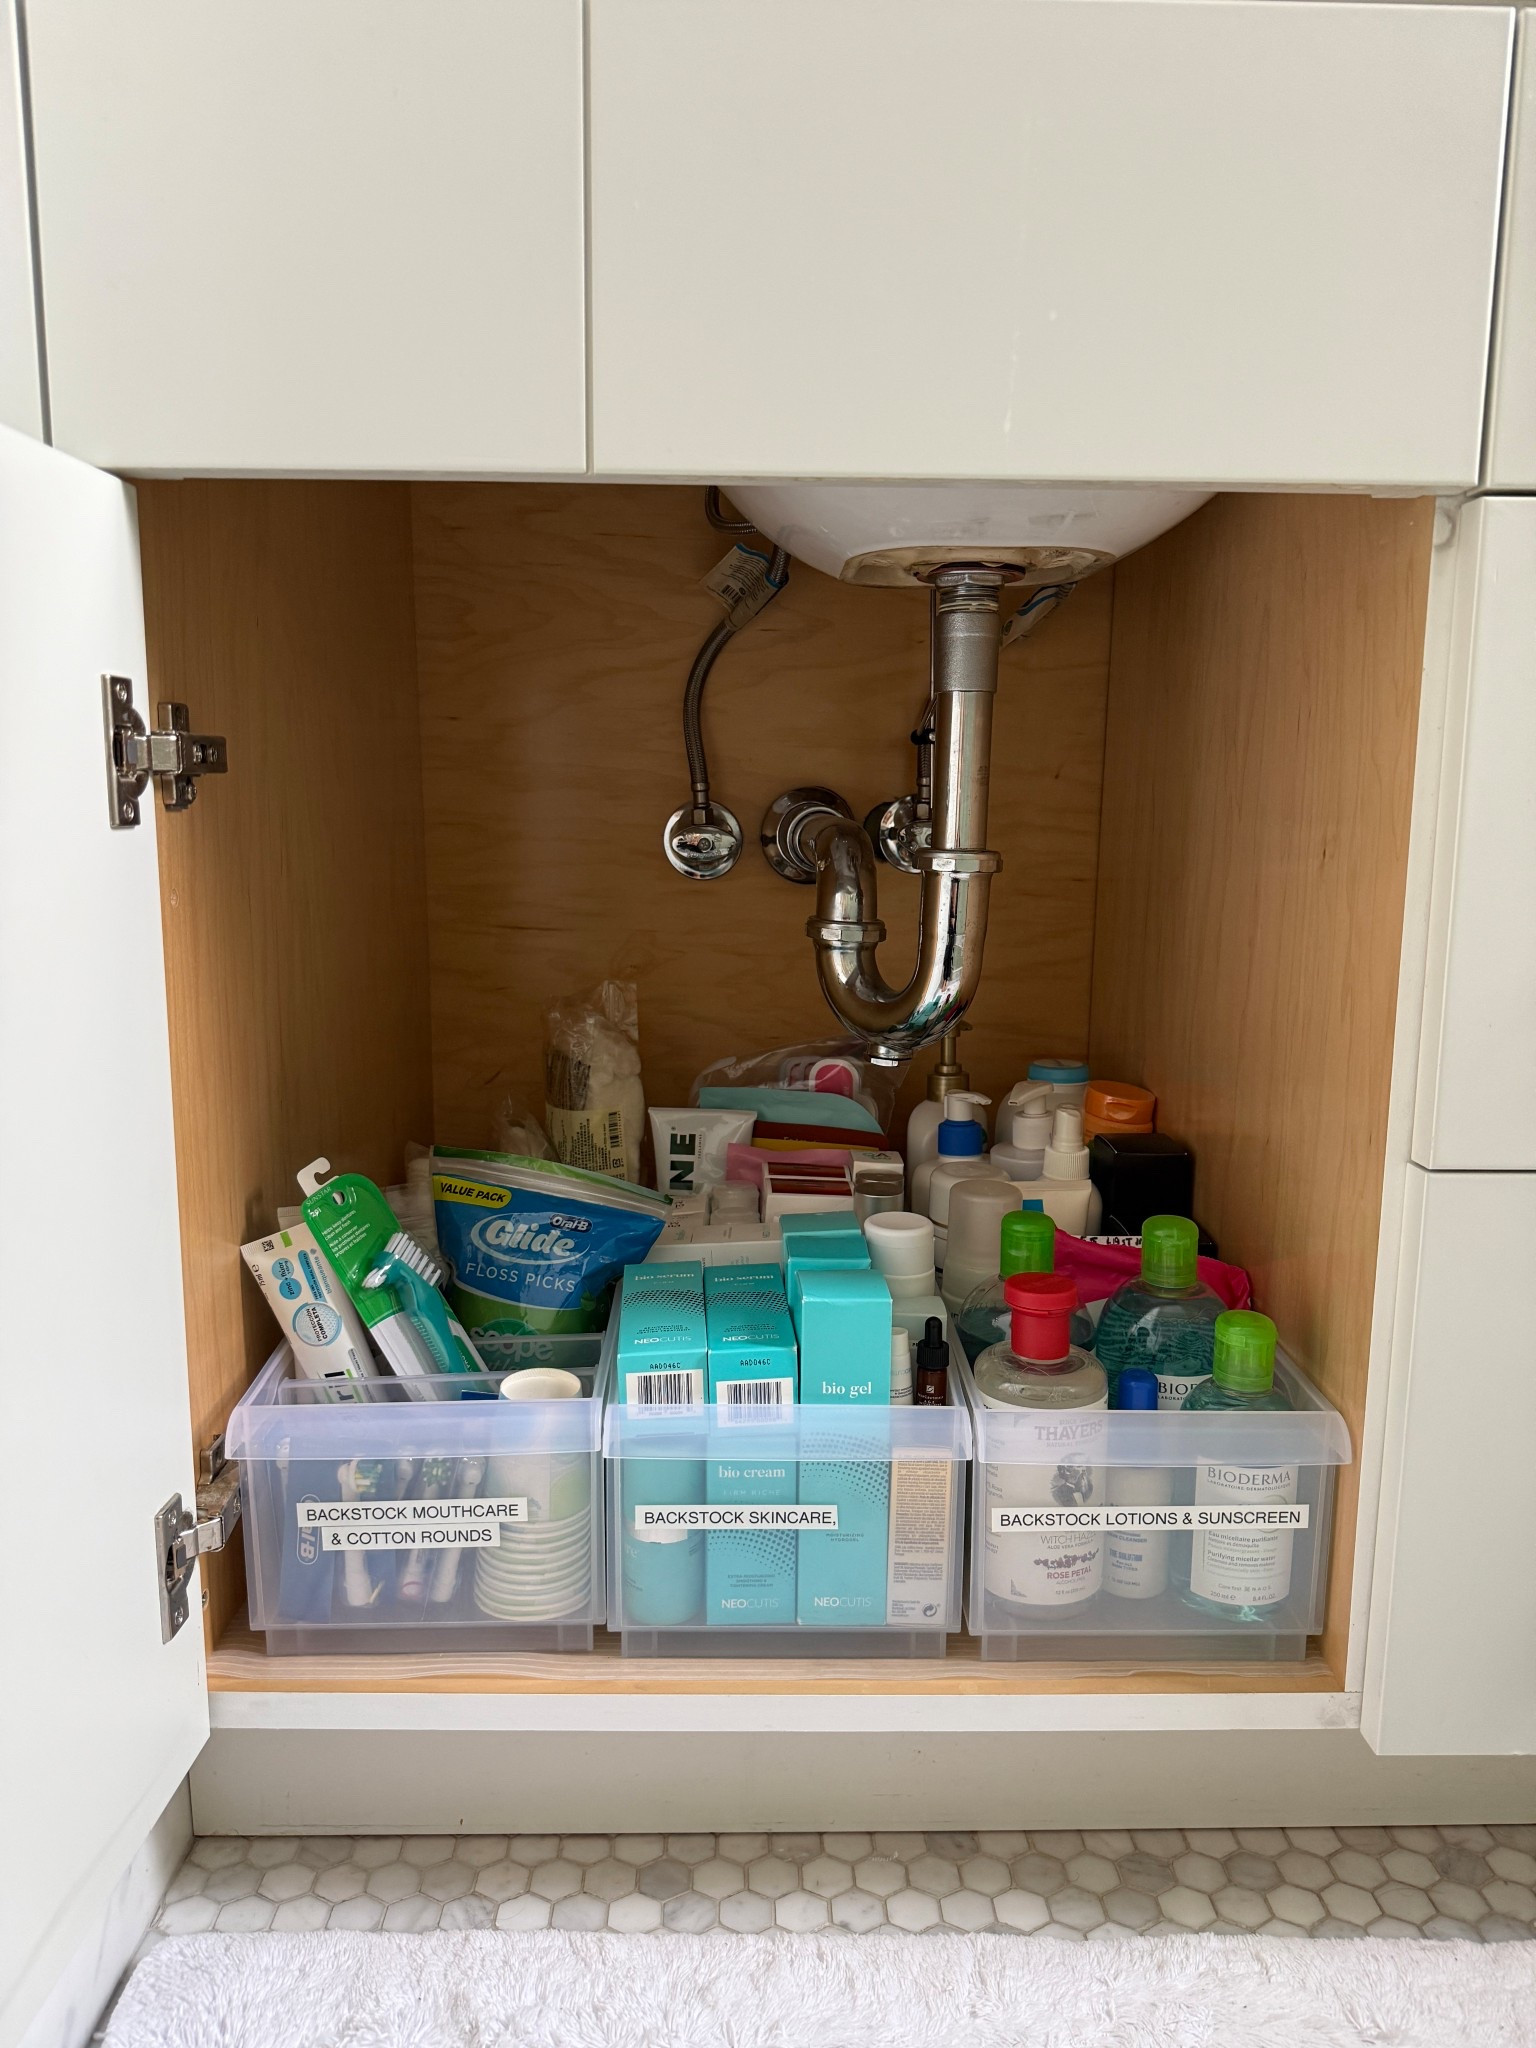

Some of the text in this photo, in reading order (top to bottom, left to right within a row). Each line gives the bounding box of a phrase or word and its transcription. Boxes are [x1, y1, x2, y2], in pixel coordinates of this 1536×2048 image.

[306, 1186, 332, 1206] SUNSTAR
[440, 1182, 507, 1202] VALUE PACK
[552, 1216, 589, 1231] Oral-B
[486, 1219, 575, 1256] Glide
[465, 1262, 576, 1292] FLOSS PICKS
[312, 1307, 328, 1340] COMPLETA
[634, 1335, 692, 1344] NEOCUTIS
[722, 1333, 780, 1342] NEOCUTIS
[822, 1381, 846, 1395] bio
[850, 1381, 872, 1398] gel
[1034, 1420, 1103, 1440] THAYERS
[718, 1465, 785, 1478] bio cream
[1208, 1466, 1290, 1486] BIODERMA
[306, 1504, 519, 1522] BACKSTOCK MOUTHCARE
[644, 1510, 836, 1528] BACKSTOCK SKINCARE,
[1000, 1512, 1300, 1526] BACKSTOCK LOTIONS & SUNSCREEN
[332, 1528, 492, 1545] & COTTON ROUNDS
[1041, 1534, 1072, 1545] WITCH
[1208, 1530, 1220, 1538] Eau
[1221, 1534, 1250, 1542] micellaire
[1208, 1550, 1235, 1562] Purifying
[1046, 1566, 1092, 1580] ROSE PETAL
[722, 1598, 778, 1609] NEOCUTIS
[814, 1596, 872, 1607] NEOCUTIS
